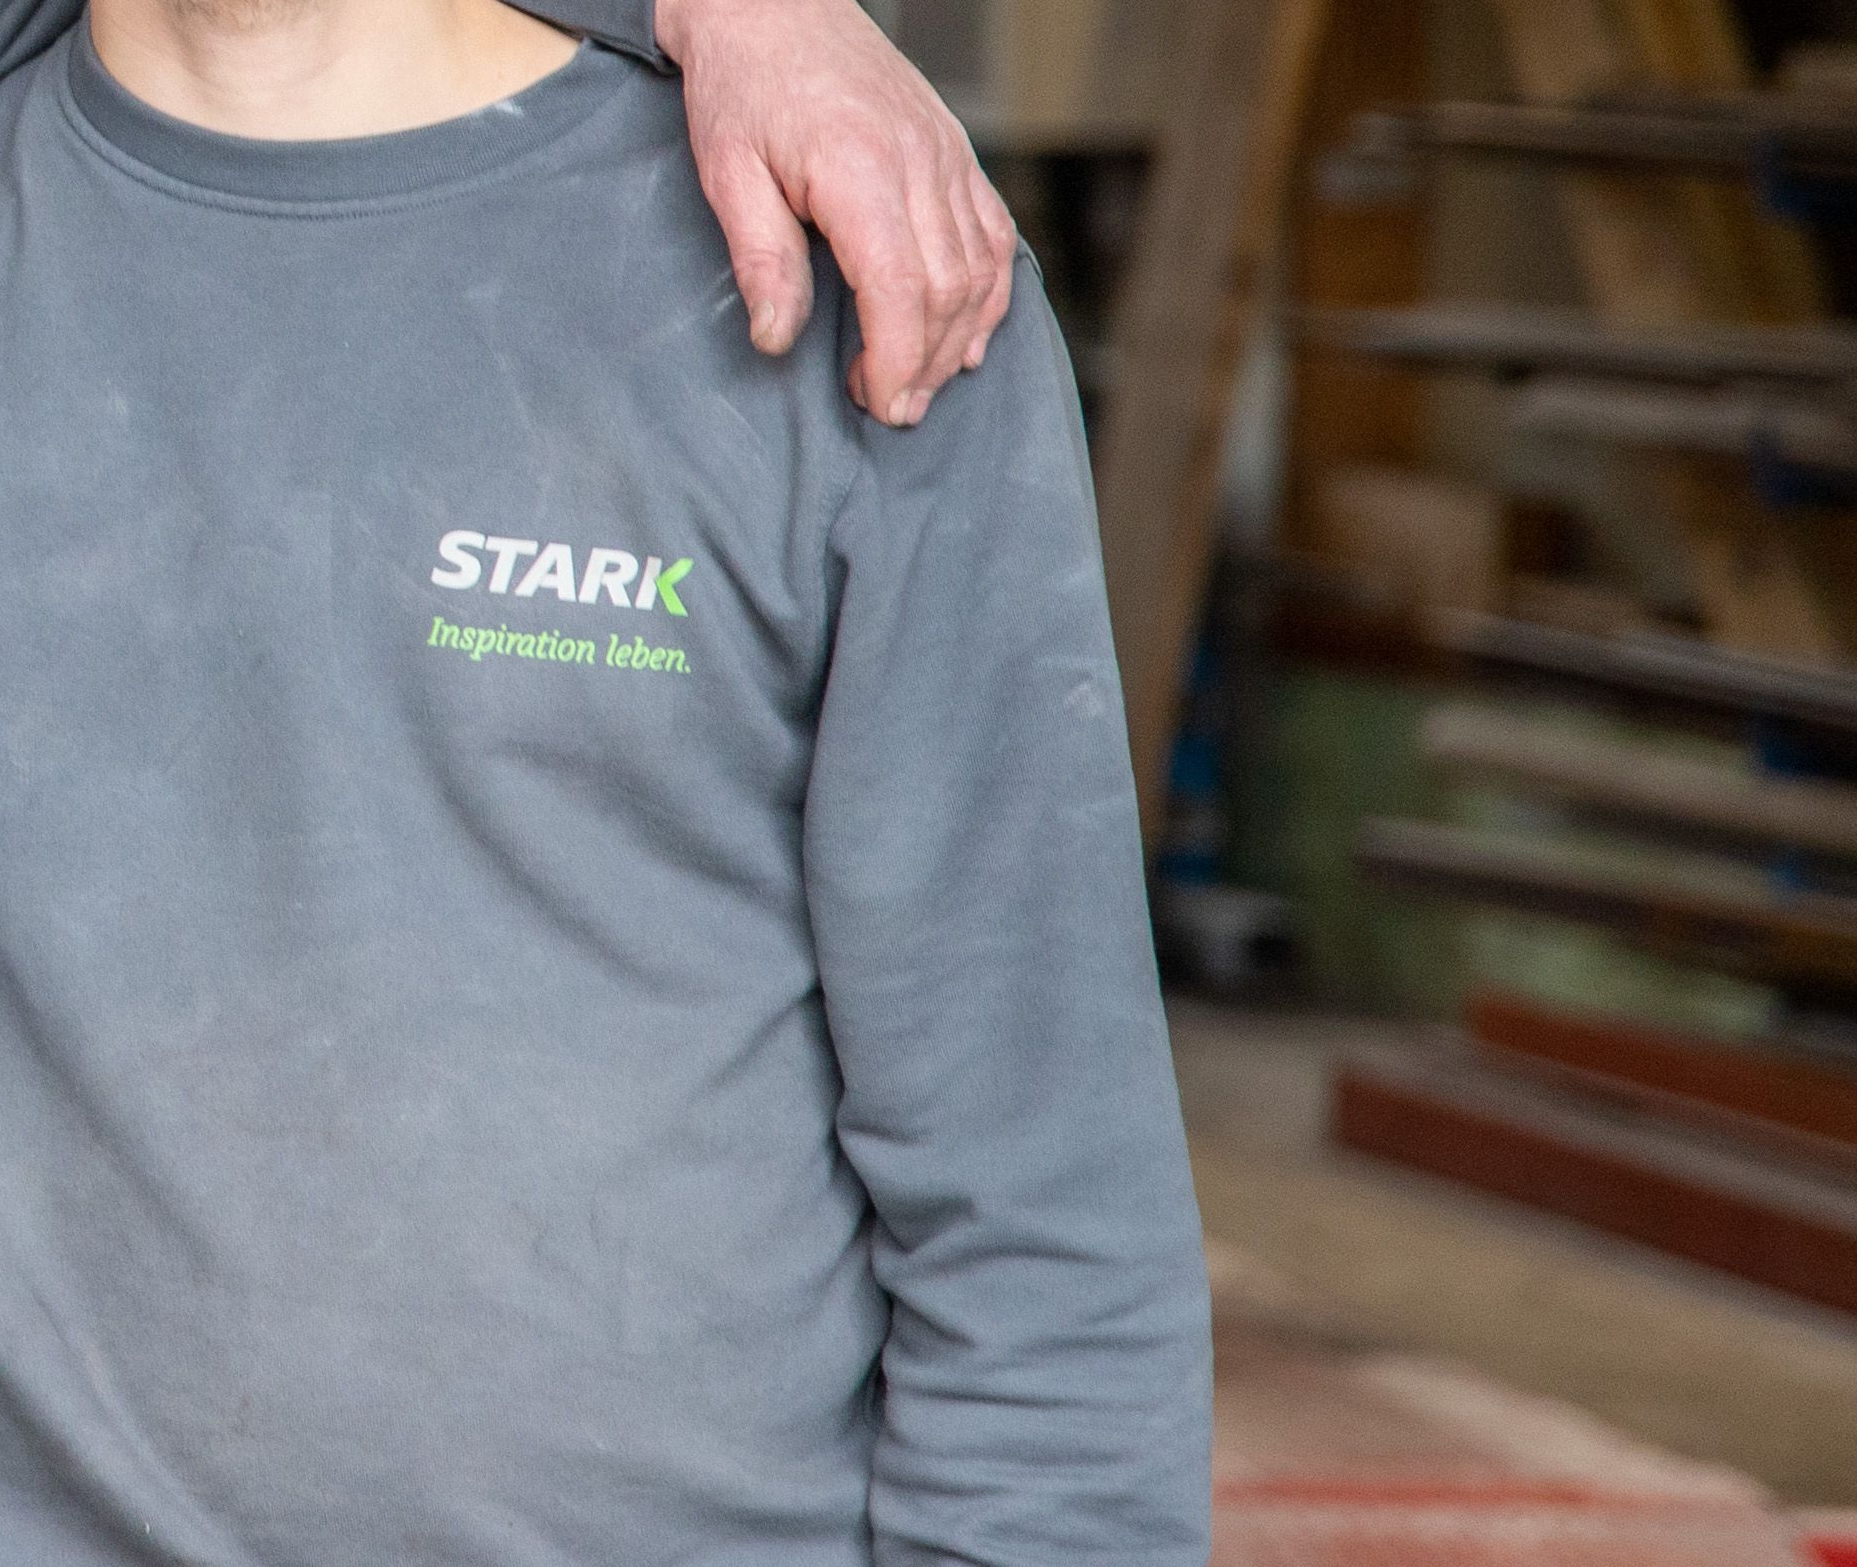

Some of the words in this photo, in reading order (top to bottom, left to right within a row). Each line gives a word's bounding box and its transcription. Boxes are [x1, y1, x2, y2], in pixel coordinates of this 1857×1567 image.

[431, 530, 694, 617] STARK
[427, 616, 595, 664] Inspiration
[606, 634, 691, 673] leben.
